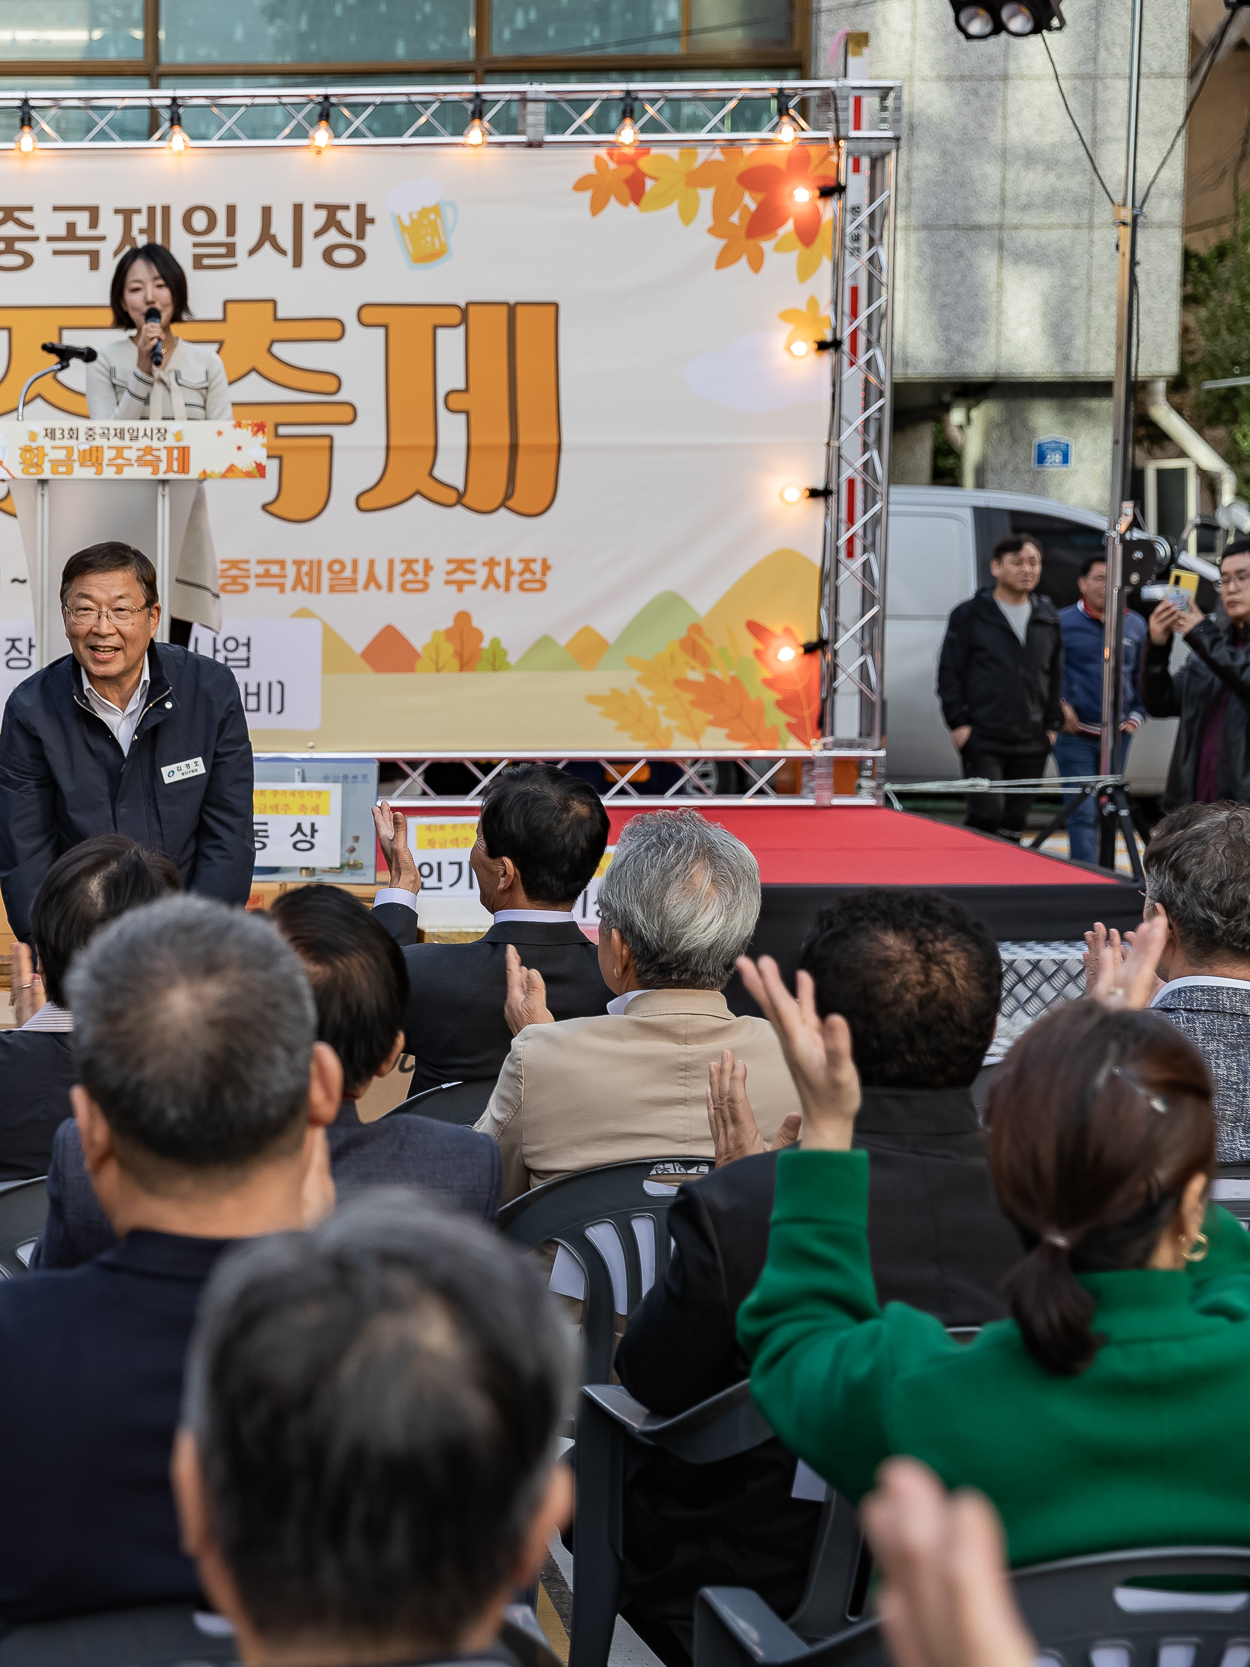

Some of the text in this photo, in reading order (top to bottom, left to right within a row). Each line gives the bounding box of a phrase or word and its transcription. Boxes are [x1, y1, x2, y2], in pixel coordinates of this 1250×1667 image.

[43, 426, 168, 442] 제3회 중곡제일시장
[19, 444, 191, 476] 황금맥주축제
[218, 555, 552, 595] 중곡제일시장 주차장
[244, 679, 285, 715] 비)
